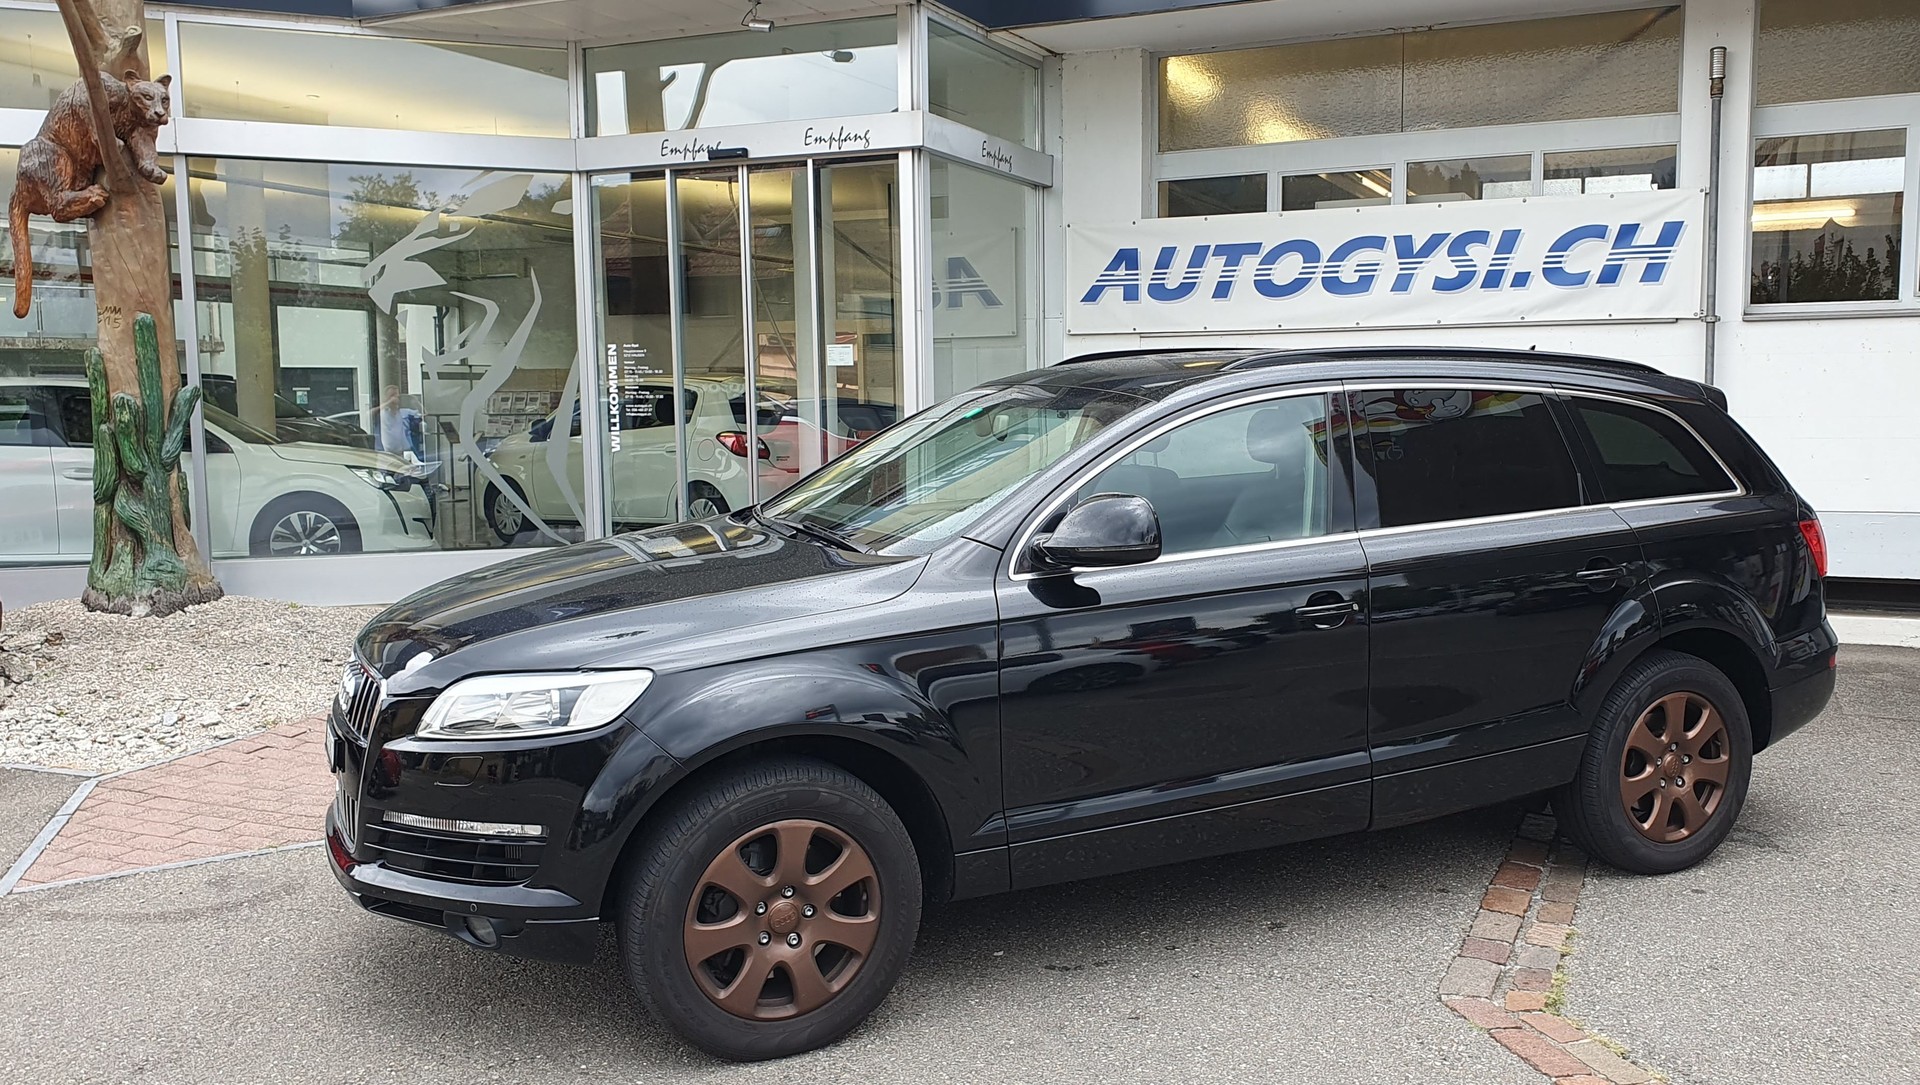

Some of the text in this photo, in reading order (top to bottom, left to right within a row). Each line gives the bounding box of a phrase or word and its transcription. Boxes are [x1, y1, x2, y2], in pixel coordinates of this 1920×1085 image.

[804, 125, 870, 150] Empfang
[982, 140, 1012, 172] Empfang
[1080, 220, 1687, 305] AUTOGYSI.CH
[607, 343, 620, 453] WILLKOMMEN
